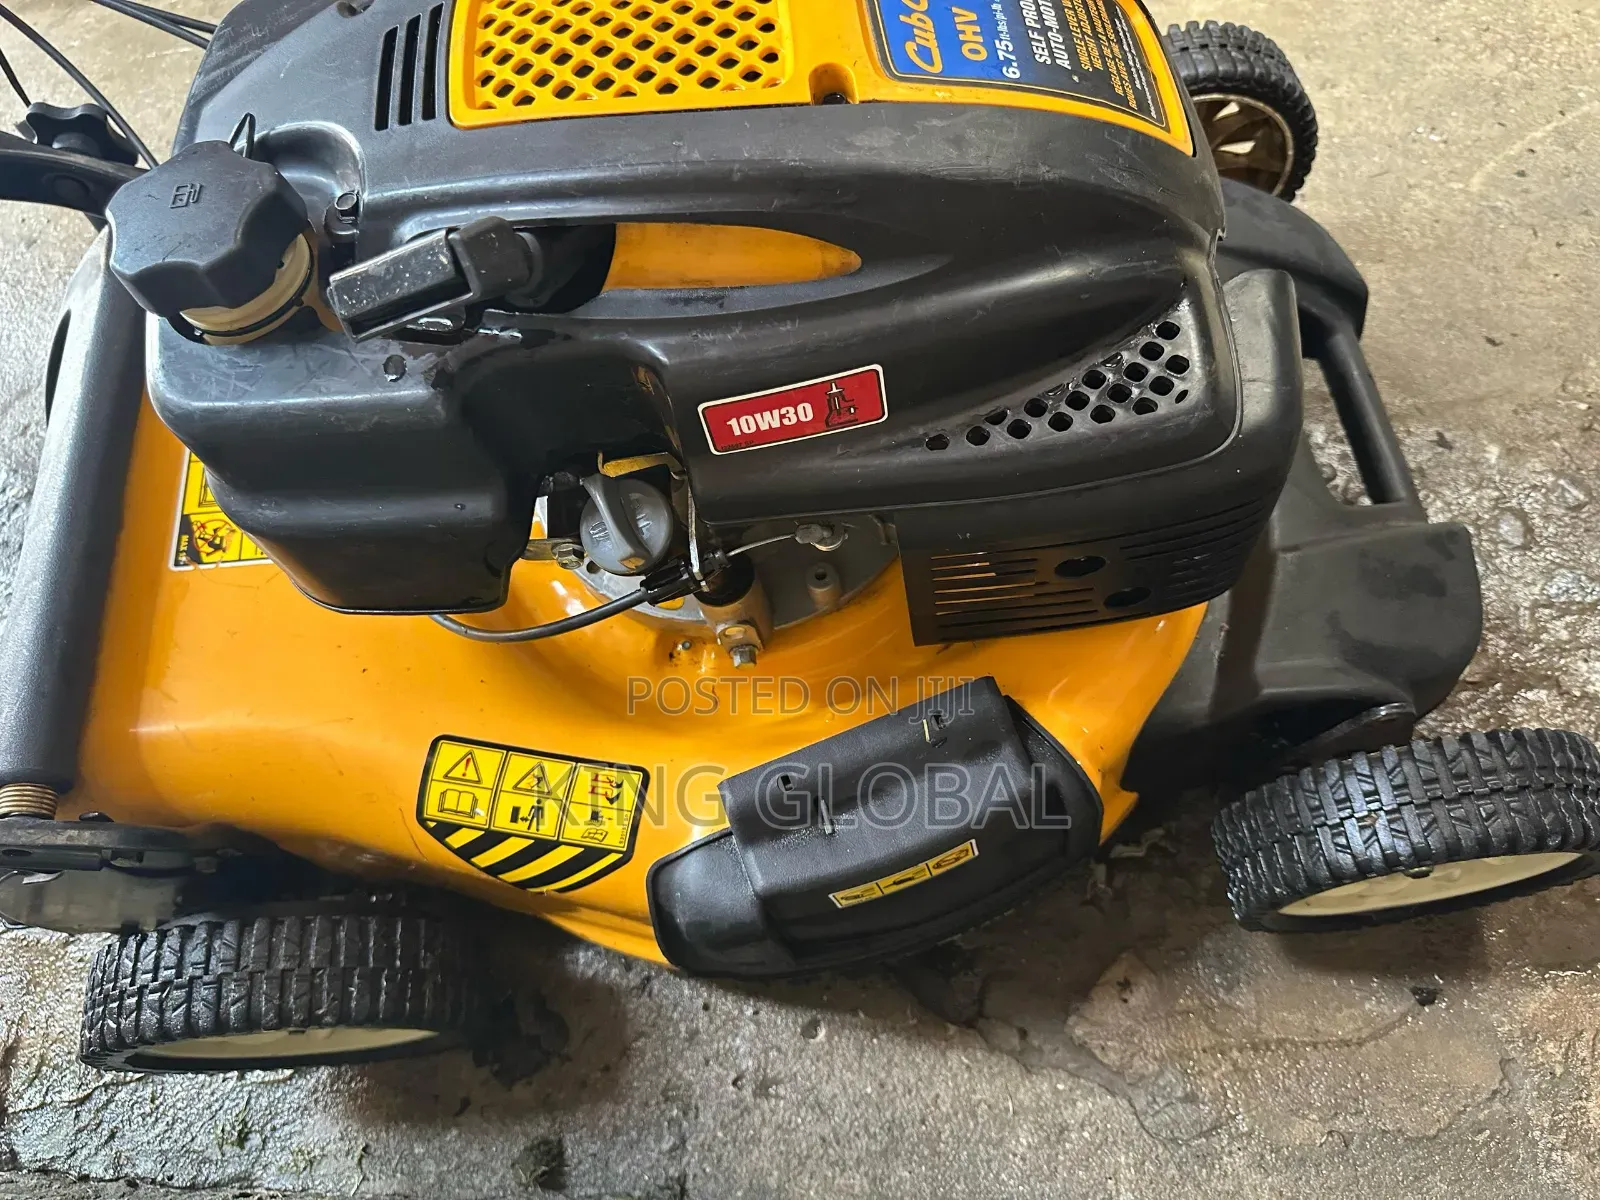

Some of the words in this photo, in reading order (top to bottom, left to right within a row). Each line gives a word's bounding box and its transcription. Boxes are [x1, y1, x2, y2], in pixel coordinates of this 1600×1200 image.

[1019, 0, 1041, 29] PRO
[1064, 8, 1083, 39] LEVER
[899, 12, 943, 74] Cub
[951, 6, 988, 61] OHV
[1027, 29, 1052, 65] SELF
[1037, 0, 1072, 70] AUTO-MOT
[994, 39, 1021, 79] 6.75
[1073, 37, 1093, 72] SINGLE
[1084, 34, 1104, 71] HEIGHT
[1115, 57, 1130, 82] AVEC
[726, 402, 814, 437] 10W30
